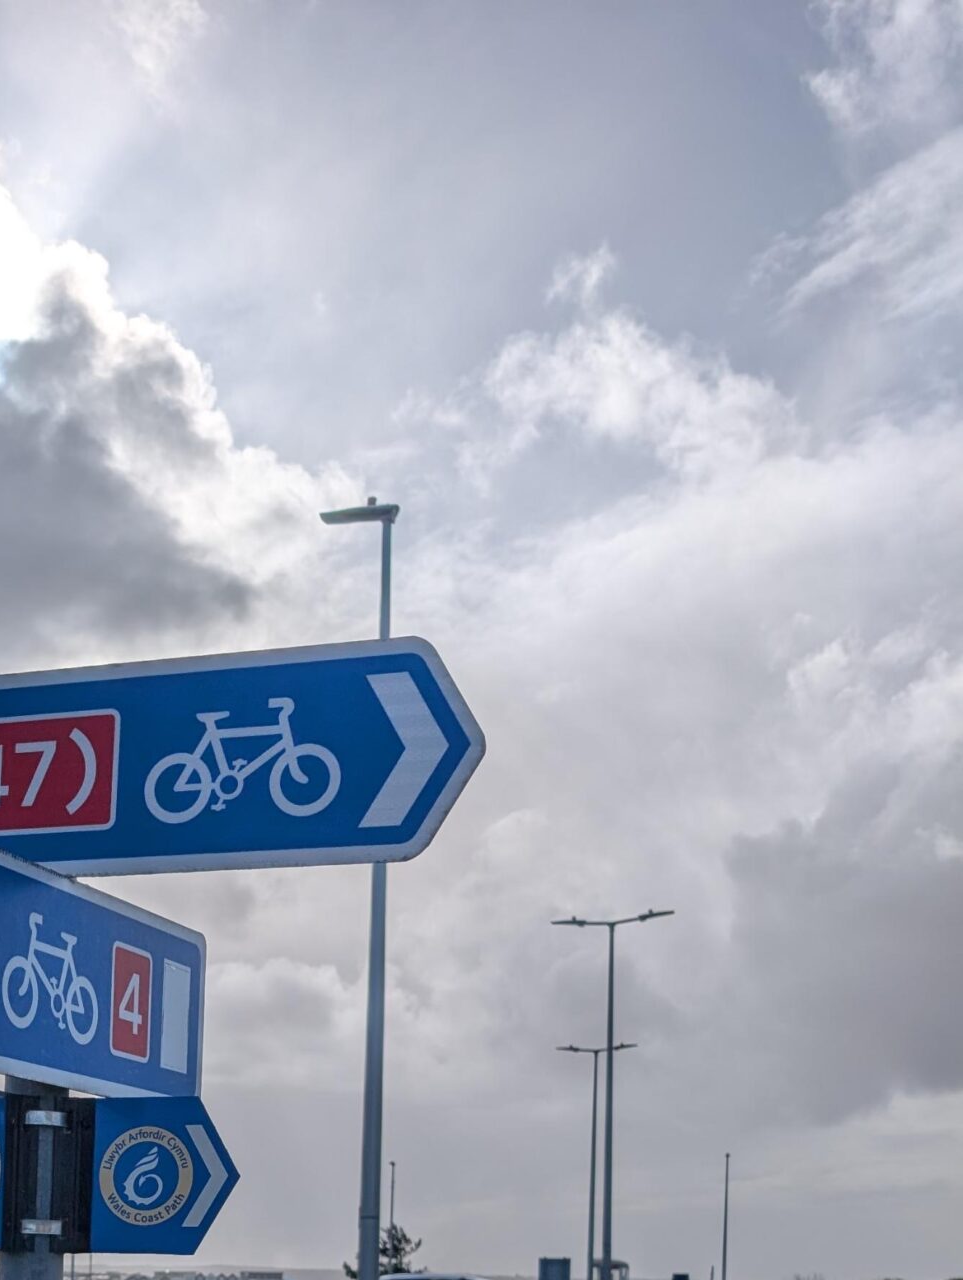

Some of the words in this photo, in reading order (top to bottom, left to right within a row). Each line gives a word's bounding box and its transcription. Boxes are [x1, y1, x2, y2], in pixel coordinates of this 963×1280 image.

[118, 972, 143, 1035] 4
[103, 1139, 126, 1170] Llwybr
[128, 1129, 167, 1143] Arfordir
[167, 1137, 189, 1169] Cymru
[107, 1193, 131, 1219] Wales
[133, 1211, 164, 1223] Coast
[164, 1193, 185, 1215] Path
